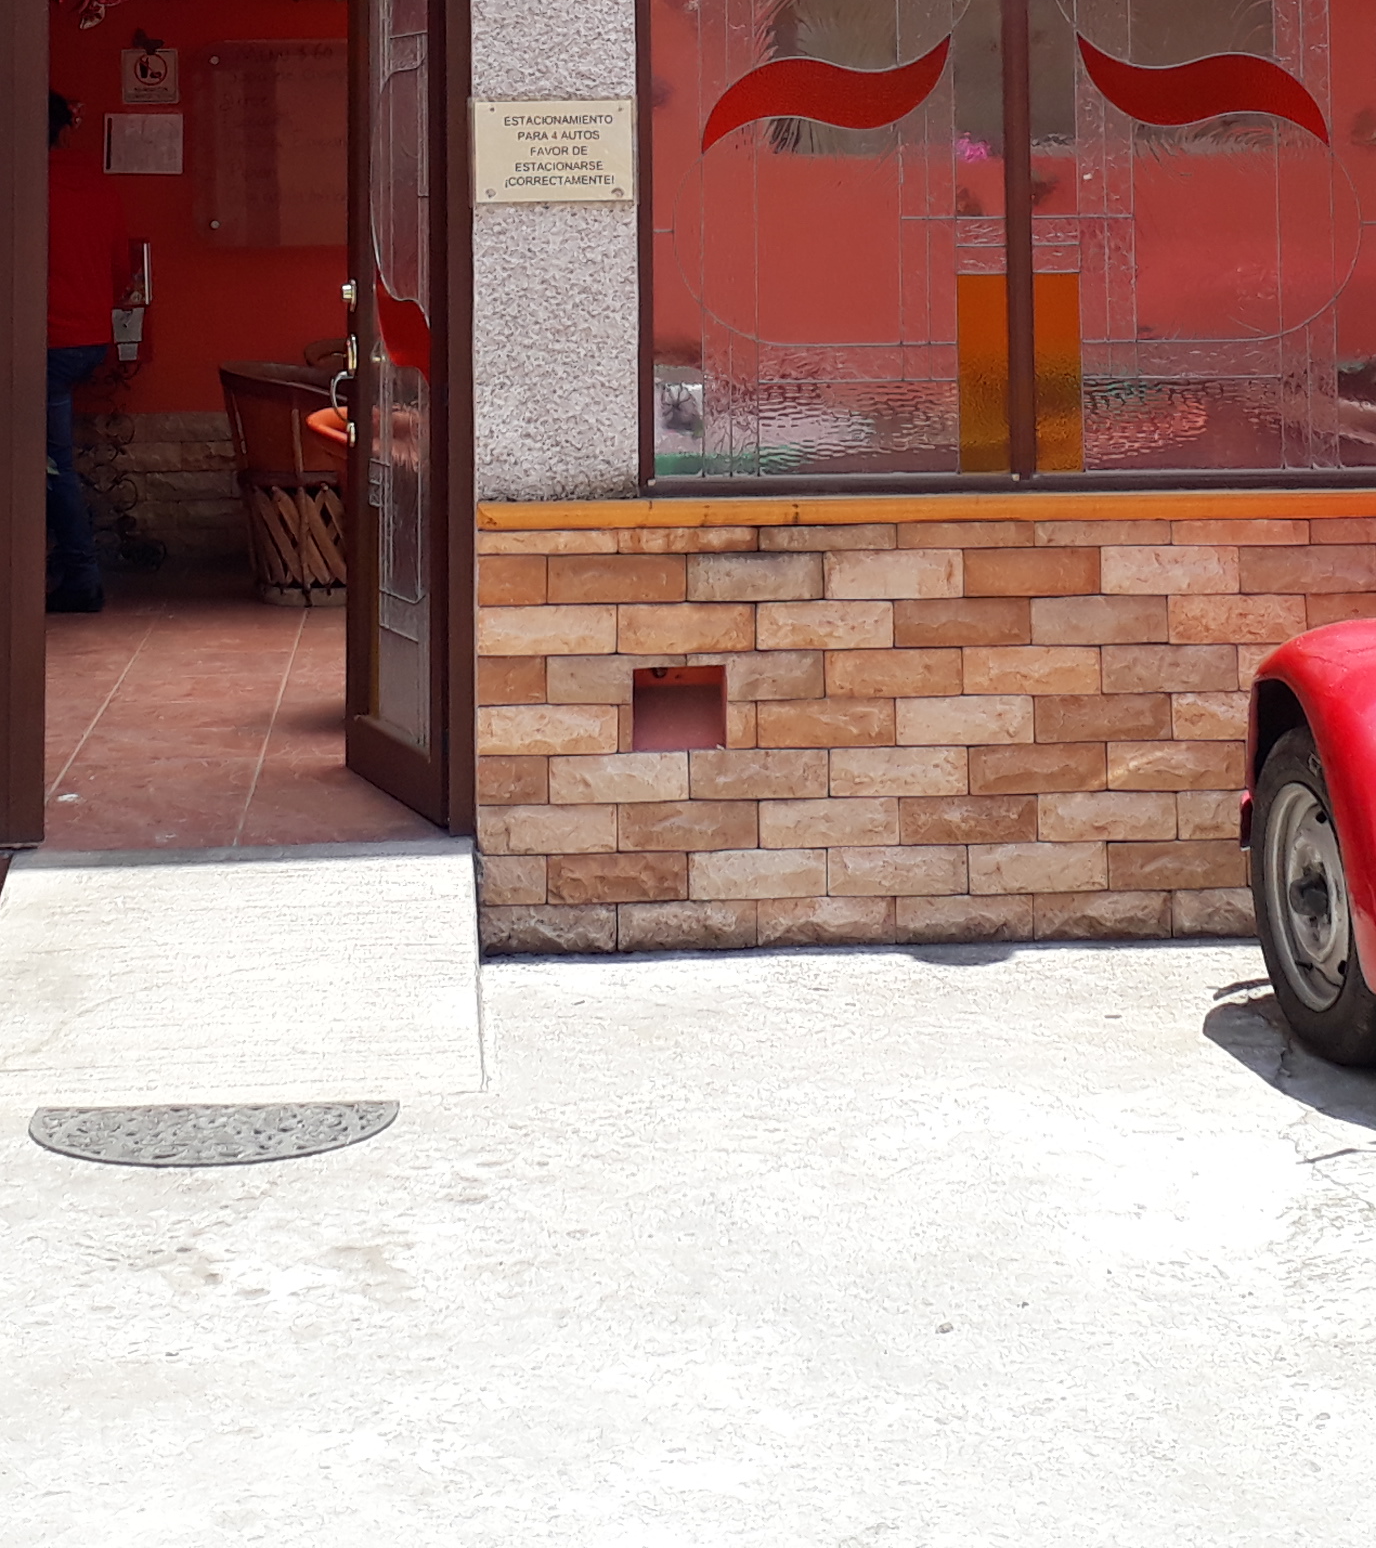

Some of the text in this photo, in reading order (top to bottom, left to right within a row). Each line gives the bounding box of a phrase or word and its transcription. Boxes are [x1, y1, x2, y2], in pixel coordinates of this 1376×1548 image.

[504, 115, 613, 126] ESTACIONAMIENTO
[517, 130, 600, 141] PARA 4 AUTOS
[530, 145, 588, 156] FAVOR DE
[515, 161, 604, 172] ESTACIONARSE
[505, 175, 615, 188] ¡CORRECTAMENTE!
